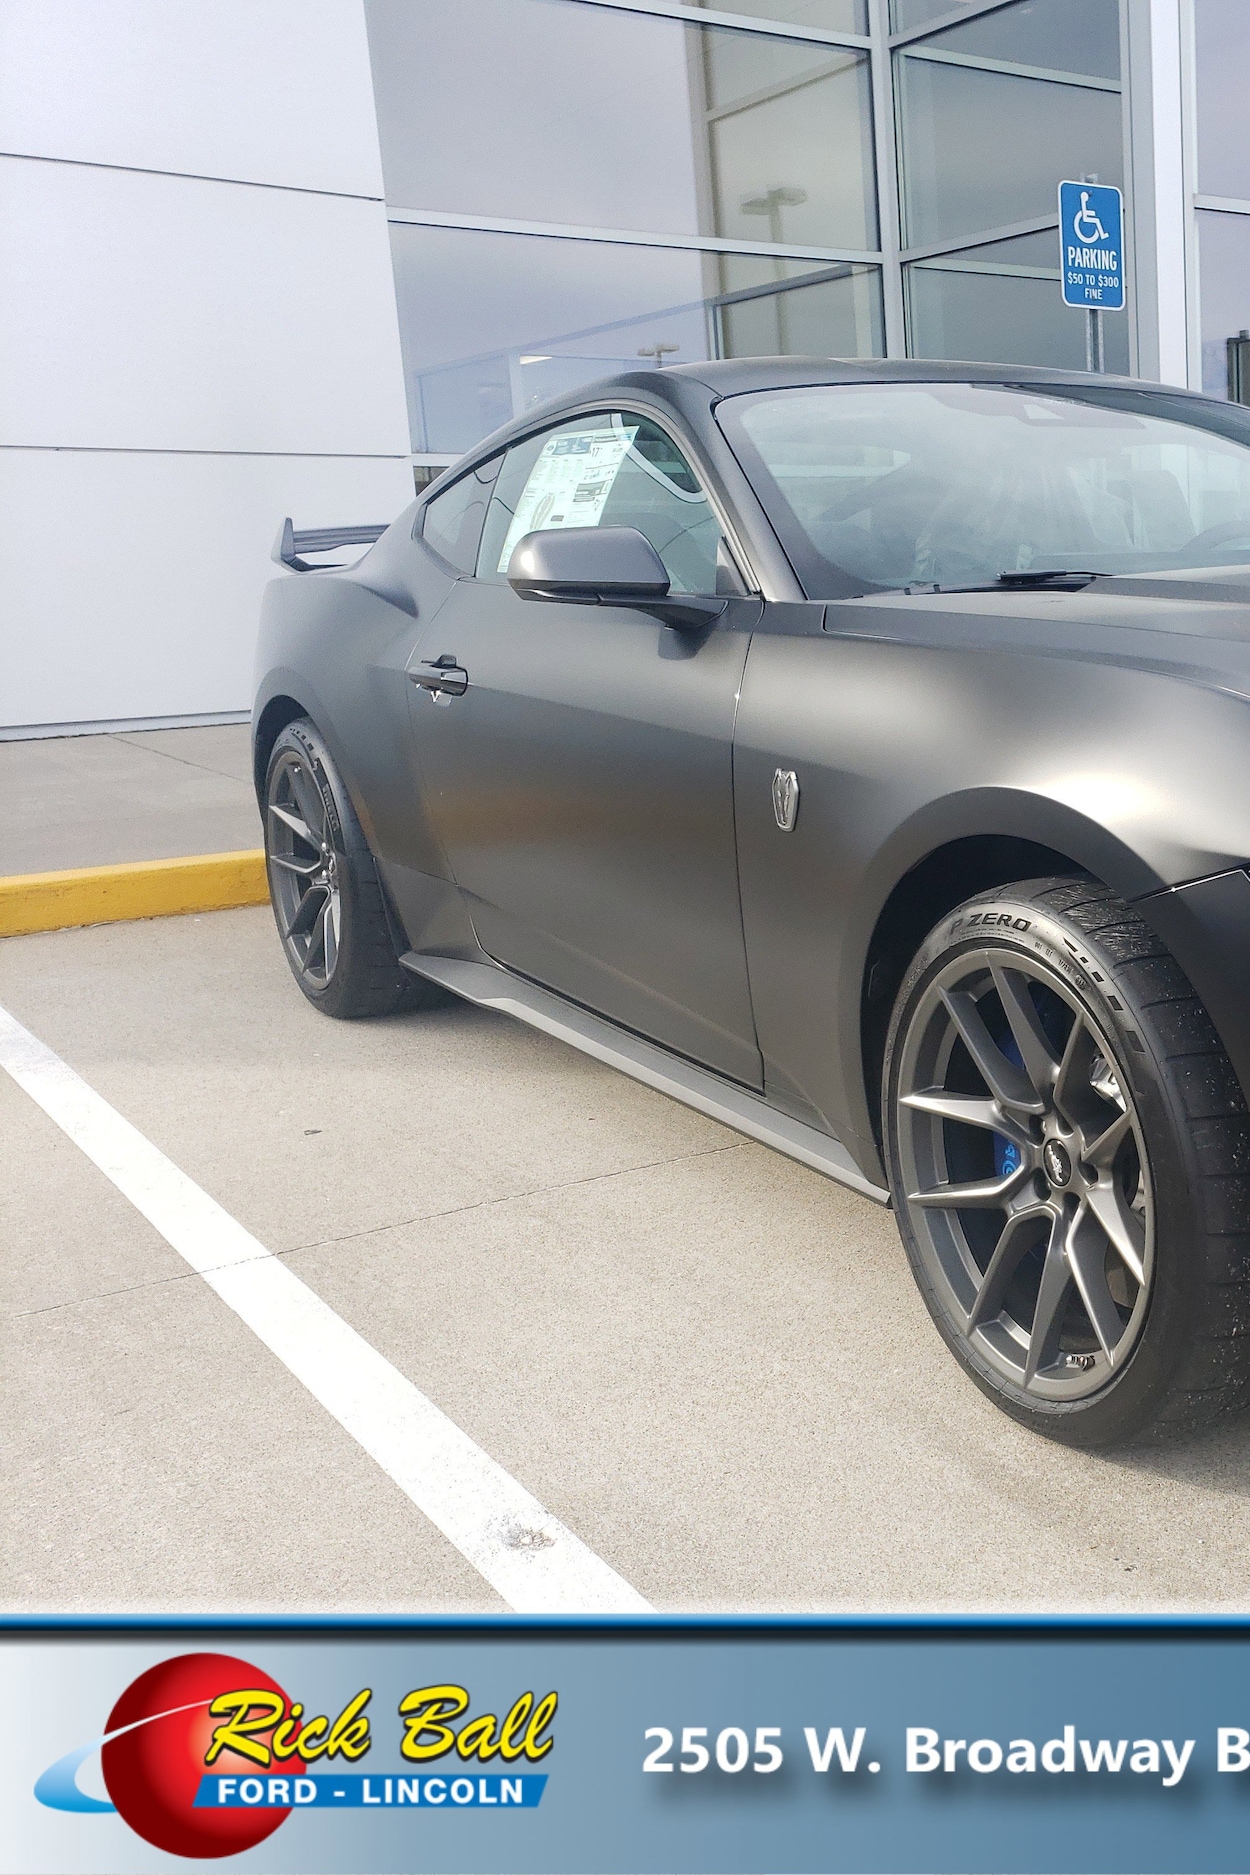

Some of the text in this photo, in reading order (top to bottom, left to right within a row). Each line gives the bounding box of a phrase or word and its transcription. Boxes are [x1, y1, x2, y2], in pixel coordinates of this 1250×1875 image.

[1067, 246, 1118, 271] PARKING
[1067, 271, 1119, 288] $50 TO $300
[1084, 288, 1103, 300] FINE
[950, 912, 1032, 934] P ZERO
